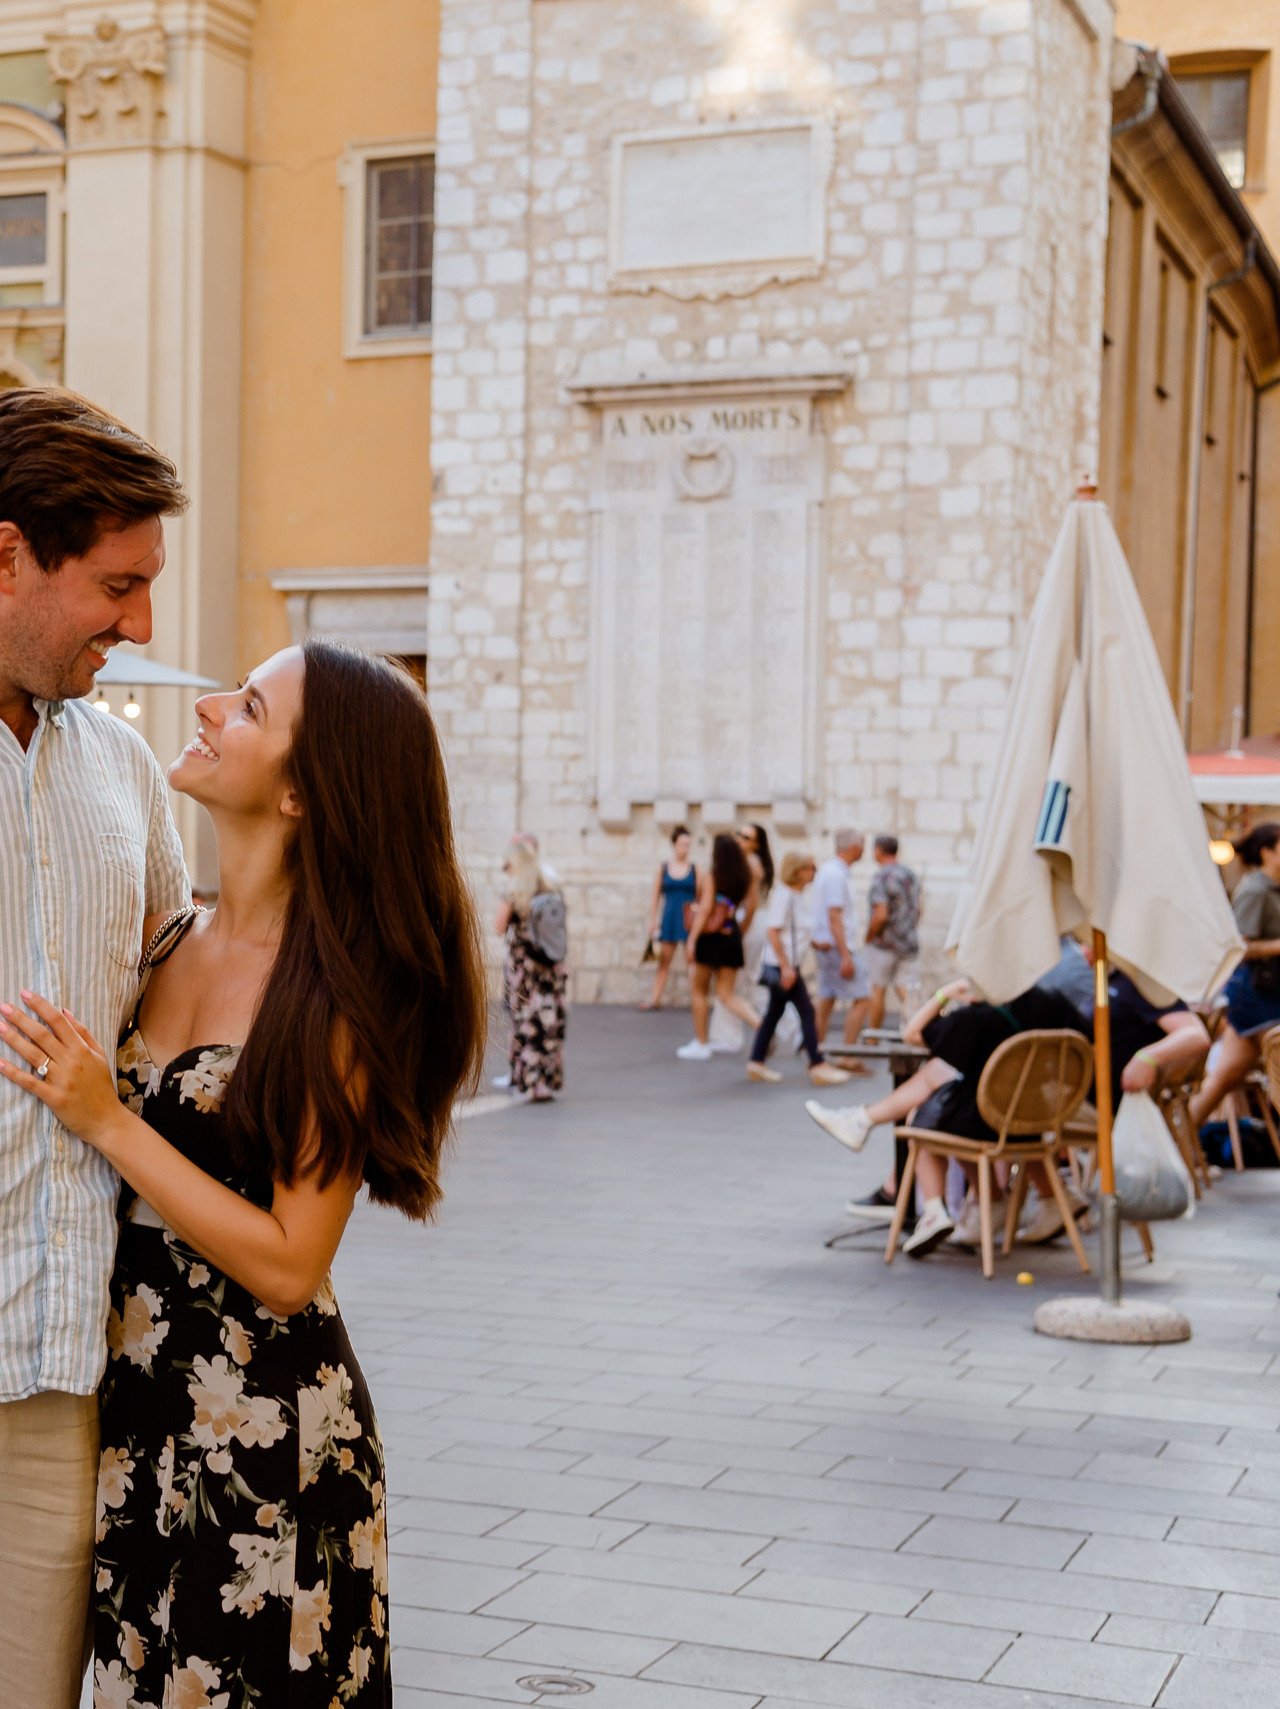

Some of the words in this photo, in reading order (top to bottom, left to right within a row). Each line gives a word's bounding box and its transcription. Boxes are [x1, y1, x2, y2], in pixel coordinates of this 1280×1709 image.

[610, 415, 627, 437] A
[641, 411, 693, 435] NOS
[707, 405, 802, 431] MORTS
